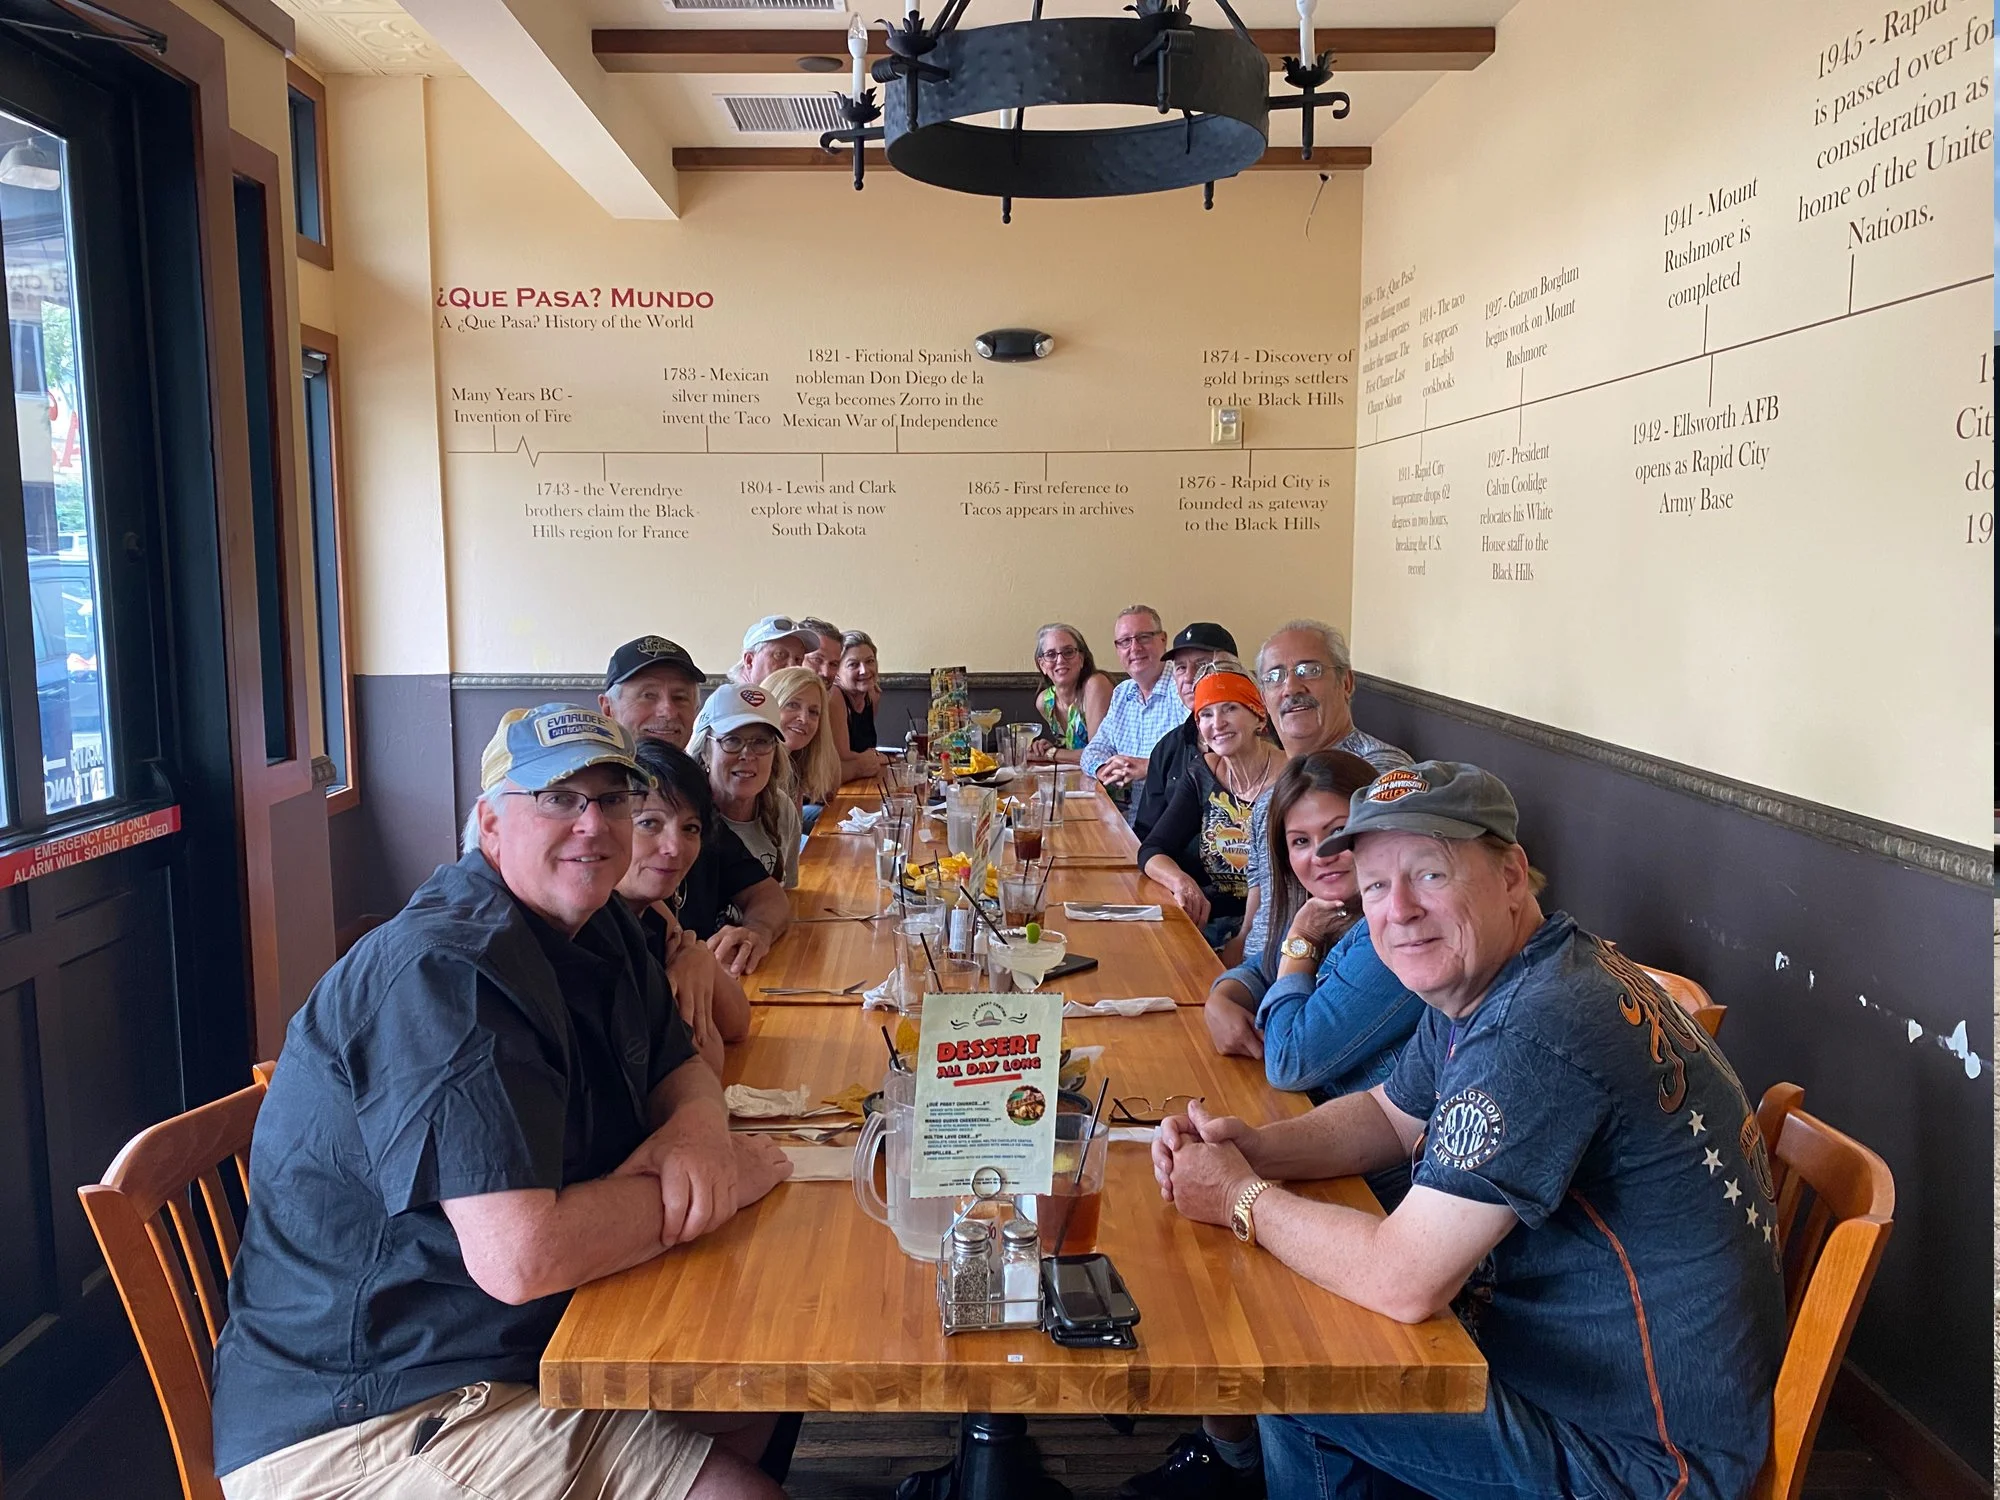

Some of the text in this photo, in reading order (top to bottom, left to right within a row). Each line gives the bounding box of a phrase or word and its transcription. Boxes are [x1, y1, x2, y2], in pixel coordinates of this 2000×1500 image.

[1818, 30, 1862, 80] 1945
[1814, 99, 1827, 126] is
[1834, 57, 1900, 123] passed
[1908, 38, 1958, 79] over
[1817, 75, 1989, 169] consideration as
[1799, 125, 1994, 222] home of the Unite
[1664, 177, 1758, 236] 1941 Mount
[1848, 205, 1934, 249] Nations.
[1664, 219, 1751, 273] Rushmore is
[1485, 266, 1579, 320] 1927 Gutzon Borglum
[1668, 261, 1741, 309] completed
[435, 287, 714, 311] ¿QUE PASA? MUNDO
[440, 313, 694, 333] A ¿Que Pasa? History of the World
[1485, 299, 1576, 348] begins work on Mount
[809, 348, 972, 367] 1821 Fictional Spanish
[1203, 348, 1356, 366] 1874 Discovery of
[1506, 342, 1548, 369] Rushmore
[663, 367, 769, 382] 1783 Mexican
[795, 369, 985, 388] nobleman Don Diego de la
[1203, 369, 1349, 389] gold brings settlers
[451, 387, 564, 405] Many Years BC
[671, 388, 760, 404] silver miners
[796, 391, 984, 409] Vega becomes Zorro in the
[1207, 391, 1344, 407] to the Black Hills
[454, 408, 572, 423] Invention of Fire
[662, 410, 771, 425] invent the Taco
[782, 412, 998, 431] Mexican War of Independence
[1633, 395, 1779, 445] 1942 Ellsworth AFB
[1488, 443, 1549, 469] 1927 President
[1635, 440, 1770, 484] opens as Rapid City
[537, 482, 683, 499] 1743 the Verendrye
[740, 479, 897, 495] 1804 Lewis and Clark
[968, 480, 1129, 495] 1865 First reference to
[1179, 474, 1330, 492] 1876 Rapid City is
[1487, 473, 1547, 497] Calvin Coolidge
[524, 503, 695, 518] brothers claim the Black
[750, 500, 887, 519] explore what is now
[959, 500, 1135, 519] Tacos appears in archives
[1178, 495, 1325, 513] founded as gateway
[1659, 487, 1734, 517] Army Base
[532, 524, 689, 541] Hills region for France
[771, 521, 867, 537] South Dakota
[1185, 516, 1321, 532] to the Black Hills
[35, 814, 151, 861] EMERGENCY EXIT ONLY
[14, 822, 169, 884] ALARM WILL SOUND IF OPENED
[936, 1034, 1040, 1063] DESSERT
[936, 1057, 1041, 1078] ALL DAY LONG
[1432, 1143, 1481, 1170] LIVE FAST
